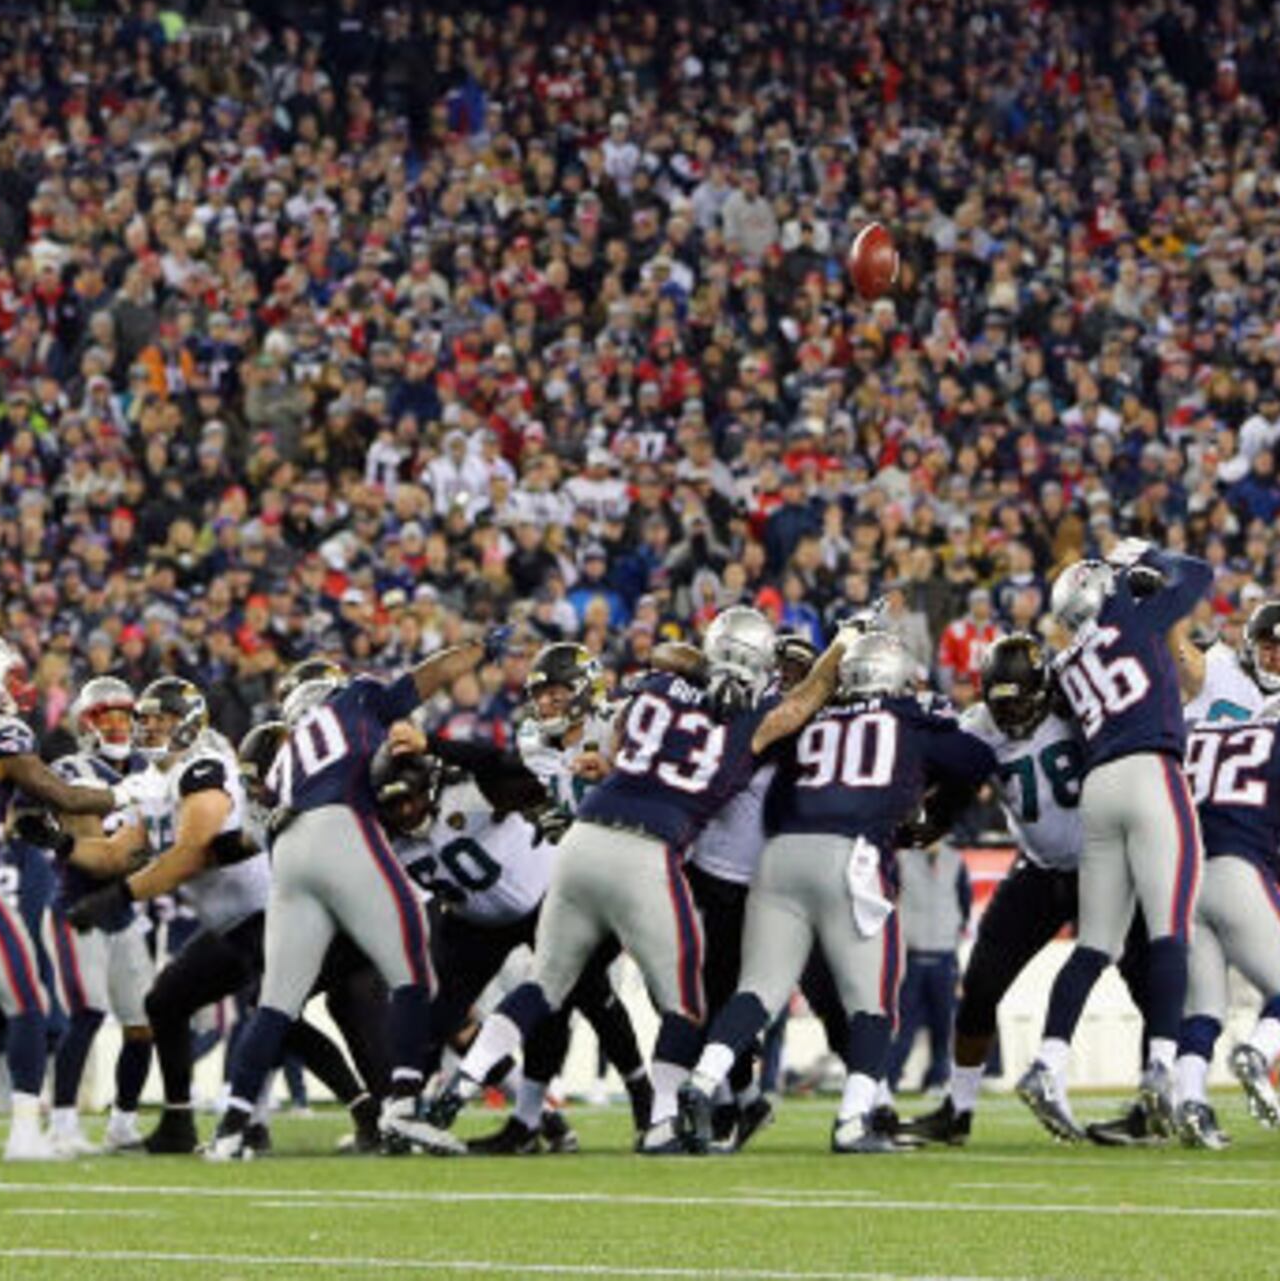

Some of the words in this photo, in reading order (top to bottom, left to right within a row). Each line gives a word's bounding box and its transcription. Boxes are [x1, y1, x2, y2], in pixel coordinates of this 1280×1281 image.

[1058, 625, 1150, 740] 96
[616, 691, 726, 793] 93
[796, 711, 897, 787] 90
[1184, 727, 1274, 806] 92
